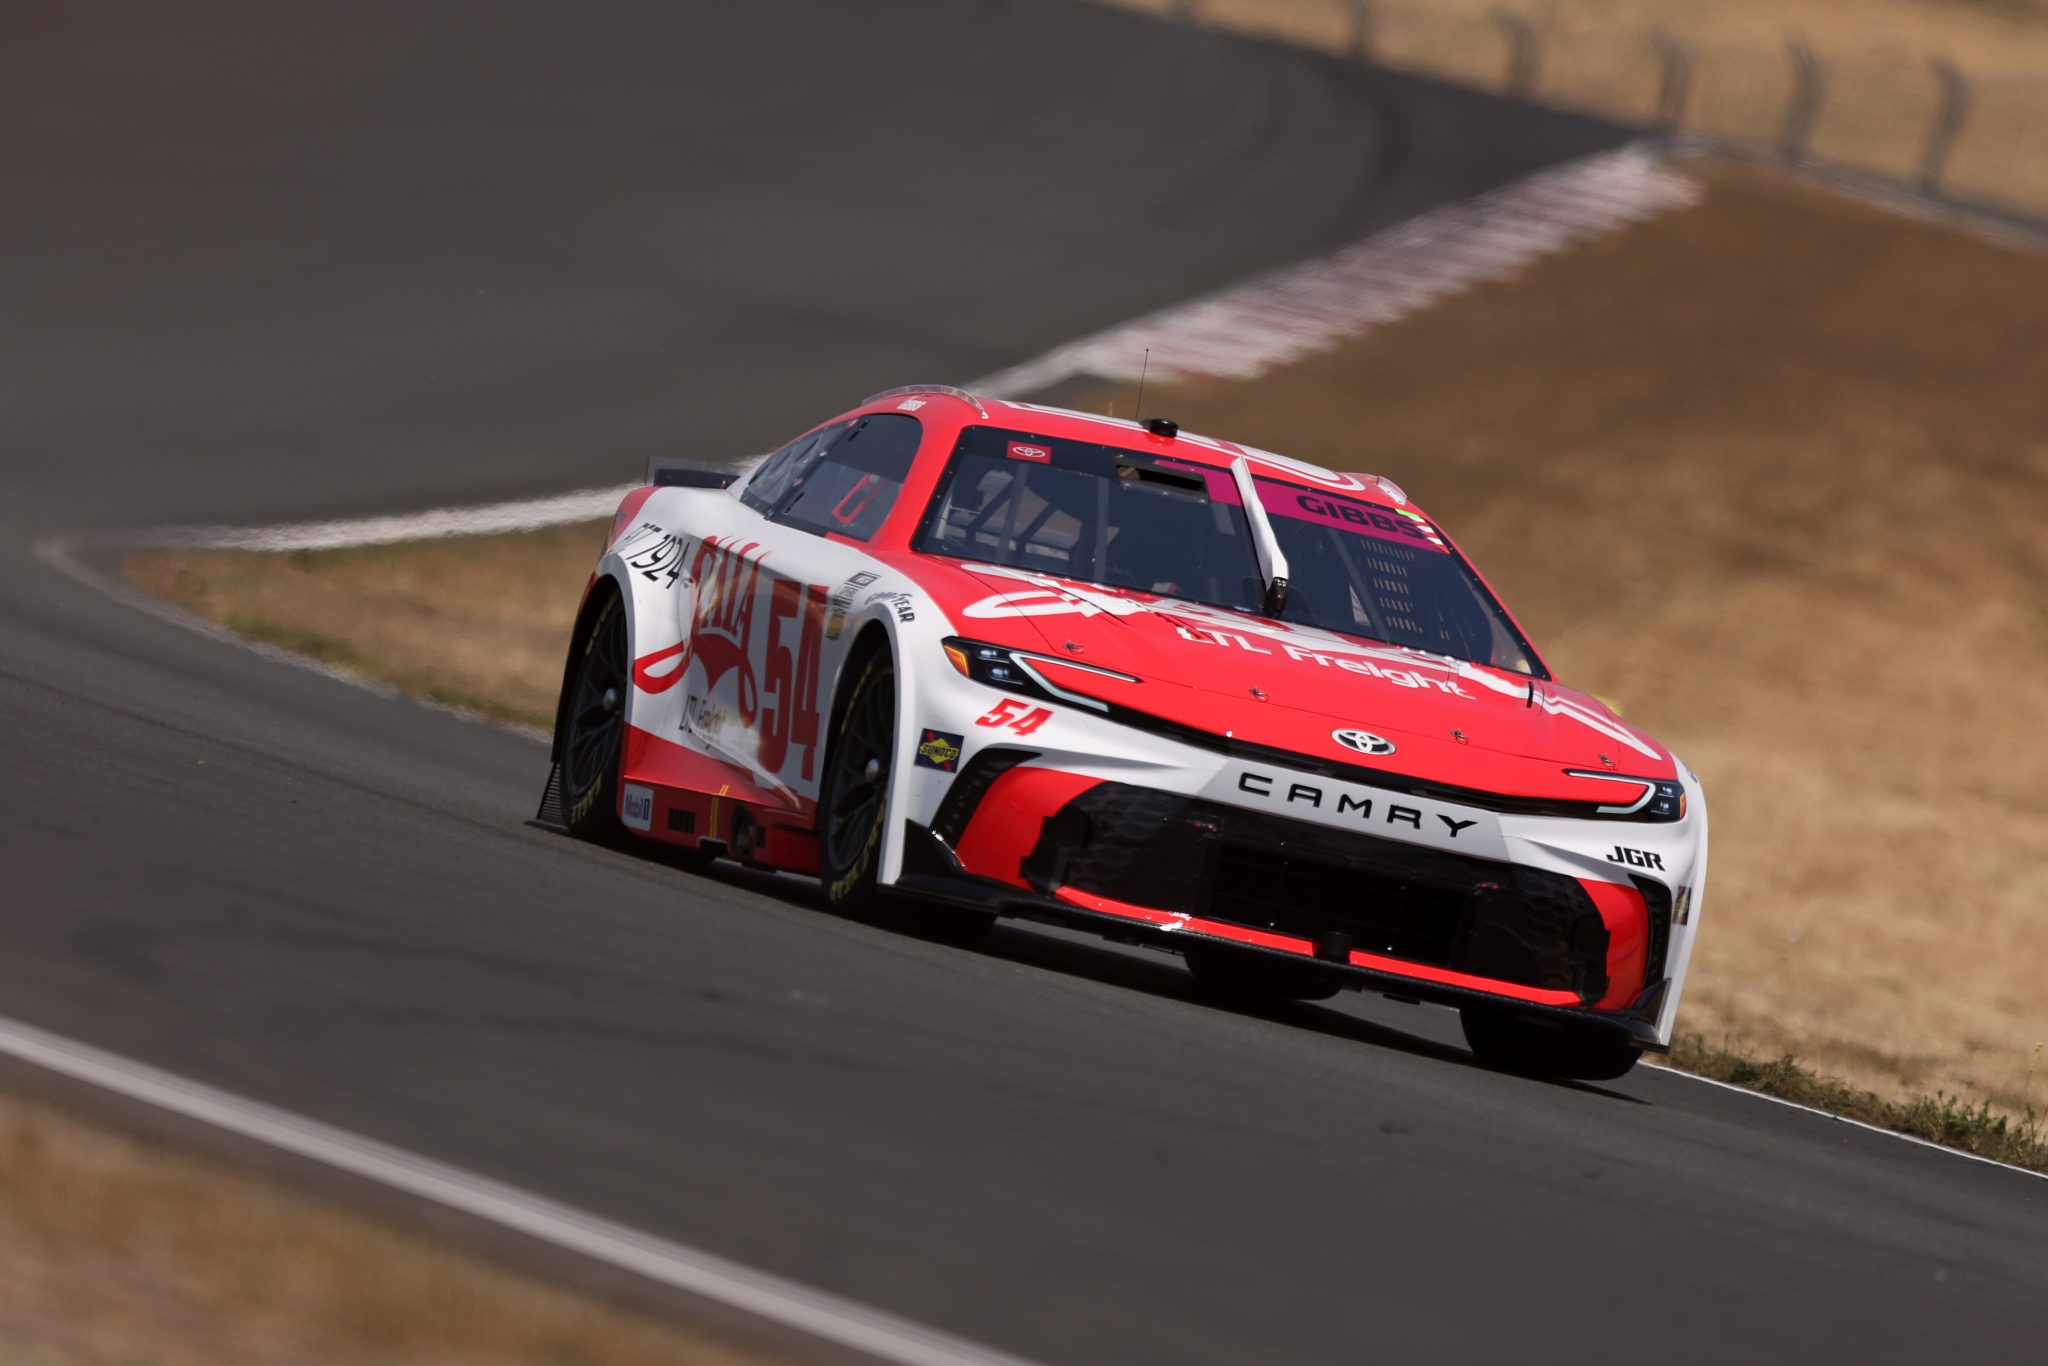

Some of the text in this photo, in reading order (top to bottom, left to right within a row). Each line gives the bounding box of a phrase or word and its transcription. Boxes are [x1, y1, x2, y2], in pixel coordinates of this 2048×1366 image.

[1297, 495, 1425, 539] GIBBS
[757, 579, 829, 781] 54
[1176, 627, 1477, 700] LTL Freight
[975, 698, 1054, 737] 54
[920, 743, 958, 760] SUNOCO
[1238, 772, 1478, 838] CAMRY
[1606, 845, 1665, 872] JGR
